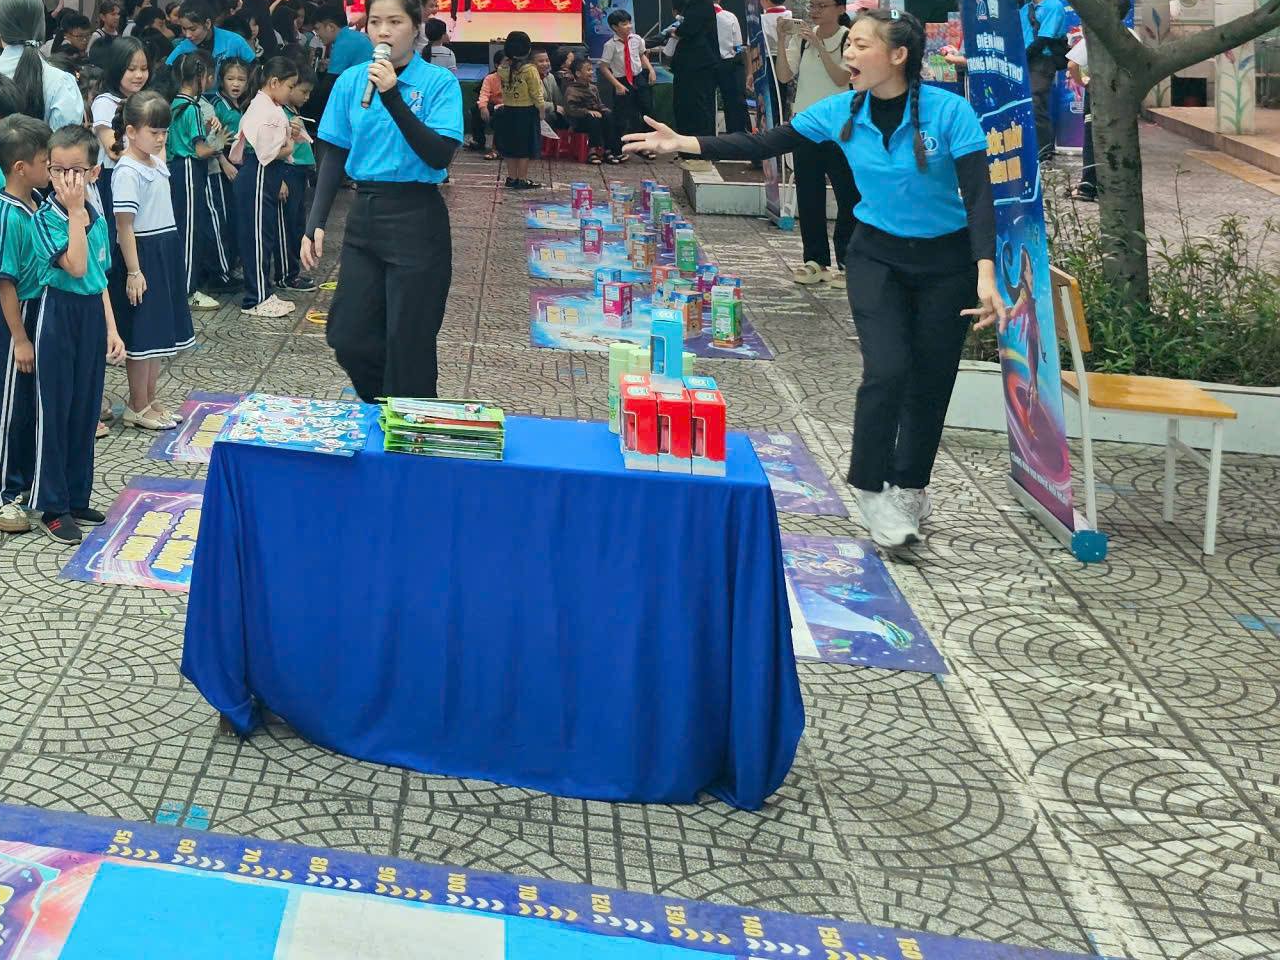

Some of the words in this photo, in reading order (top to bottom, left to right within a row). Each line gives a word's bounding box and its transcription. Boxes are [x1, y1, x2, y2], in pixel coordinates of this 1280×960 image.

[113, 829, 134, 845] 50
[176, 838, 197, 854] 60
[242, 848, 262, 863] 70
[309, 856, 329, 873] 80
[377, 866, 397, 883] 90
[447, 872, 467, 894] 100
[518, 884, 538, 902] 110
[591, 893, 612, 914] 120
[664, 905, 687, 925] 130
[740, 914, 765, 938] 140
[817, 925, 843, 949] 150
[896, 936, 924, 960] 160
